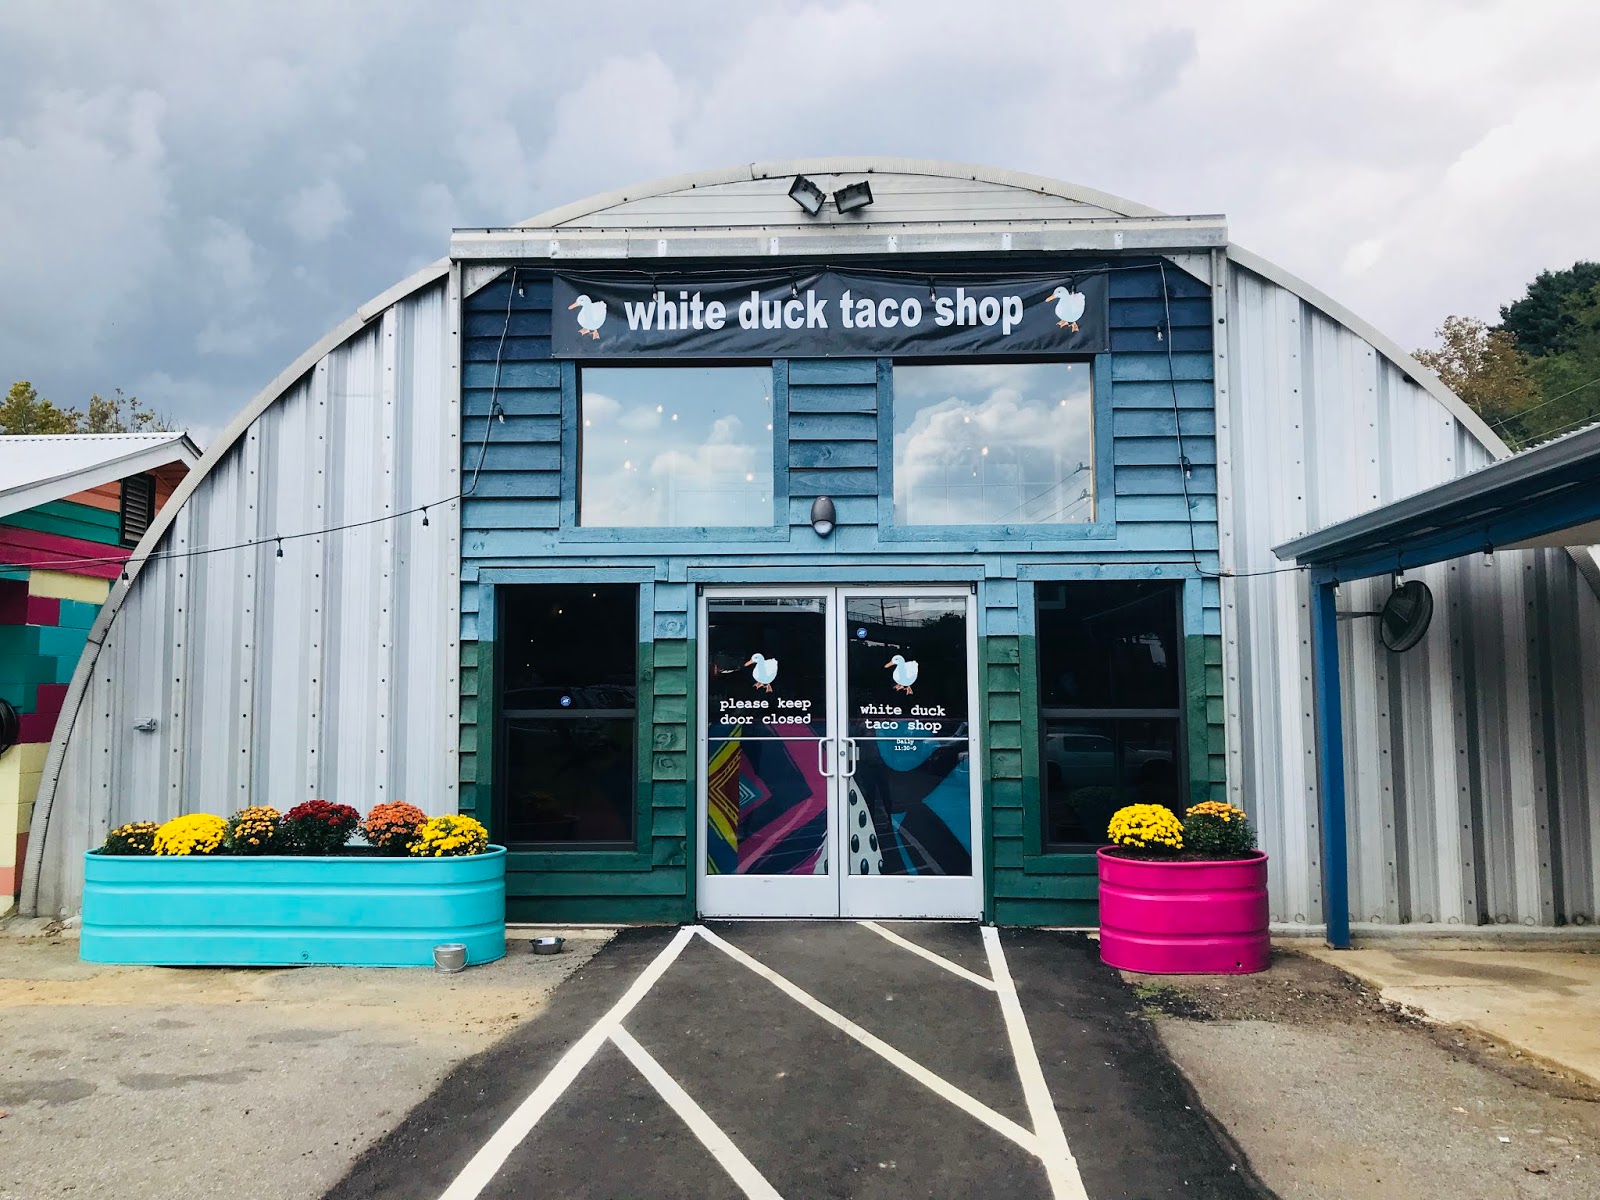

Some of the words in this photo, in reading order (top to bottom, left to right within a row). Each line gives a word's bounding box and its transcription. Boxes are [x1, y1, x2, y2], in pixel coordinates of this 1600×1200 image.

[624, 290, 727, 331] white
[738, 289, 828, 331] duck
[840, 289, 922, 329] taco
[934, 287, 1024, 336] shop
[719, 698, 769, 711] please
[778, 697, 812, 711] keep
[859, 704, 903, 716] white
[910, 704, 946, 717] duck
[720, 713, 754, 725] door
[762, 713, 811, 725] closed
[864, 718, 899, 730] taco
[907, 719, 942, 734] shop
